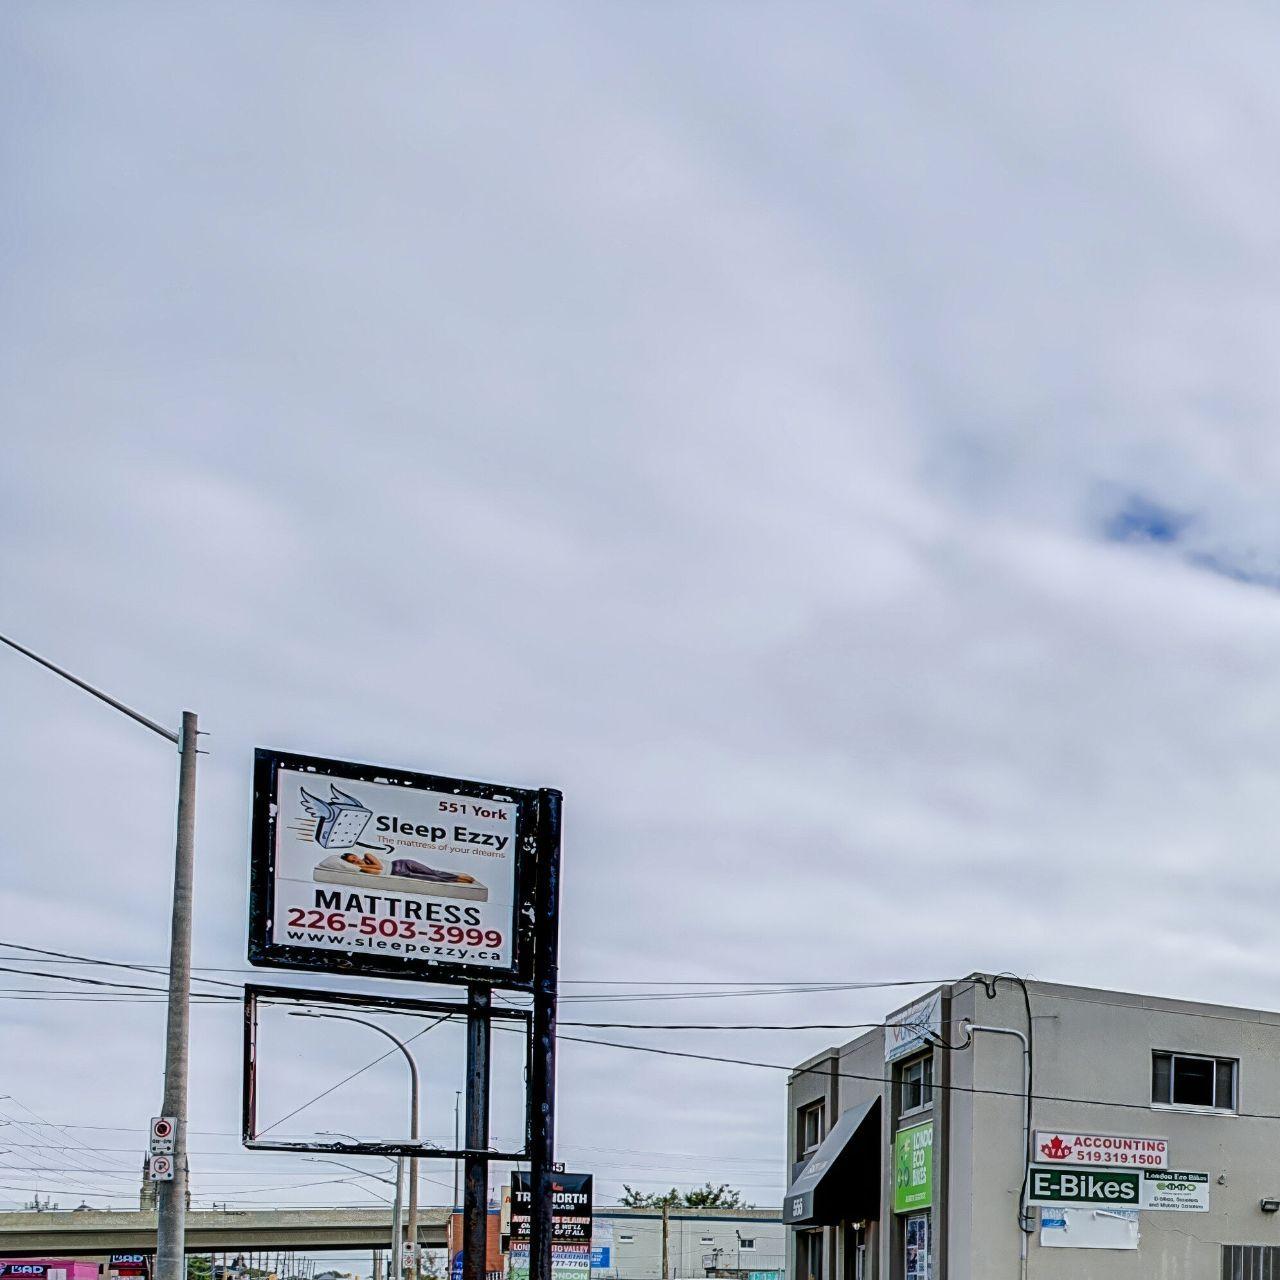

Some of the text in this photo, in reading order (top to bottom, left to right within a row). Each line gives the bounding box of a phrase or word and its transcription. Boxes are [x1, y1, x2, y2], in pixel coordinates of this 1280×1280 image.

[438, 800, 508, 821] 551 York
[376, 816, 509, 850] Sleep Ezzy
[376, 834, 394, 844] The
[396, 838, 436, 850] mattress
[450, 846, 470, 854] your
[472, 848, 506, 859] dreams
[315, 889, 480, 926] MATTRESS
[288, 908, 502, 948] 226-503-3999
[287, 929, 500, 961] www.sleepezzy.ca
[912, 1128, 933, 1150] LONDO
[1074, 1136, 1166, 1152] ACCOUNTING
[1077, 1150, 1162, 1165] 519.319.1500
[1034, 1173, 1135, 1199] E-Bikes
